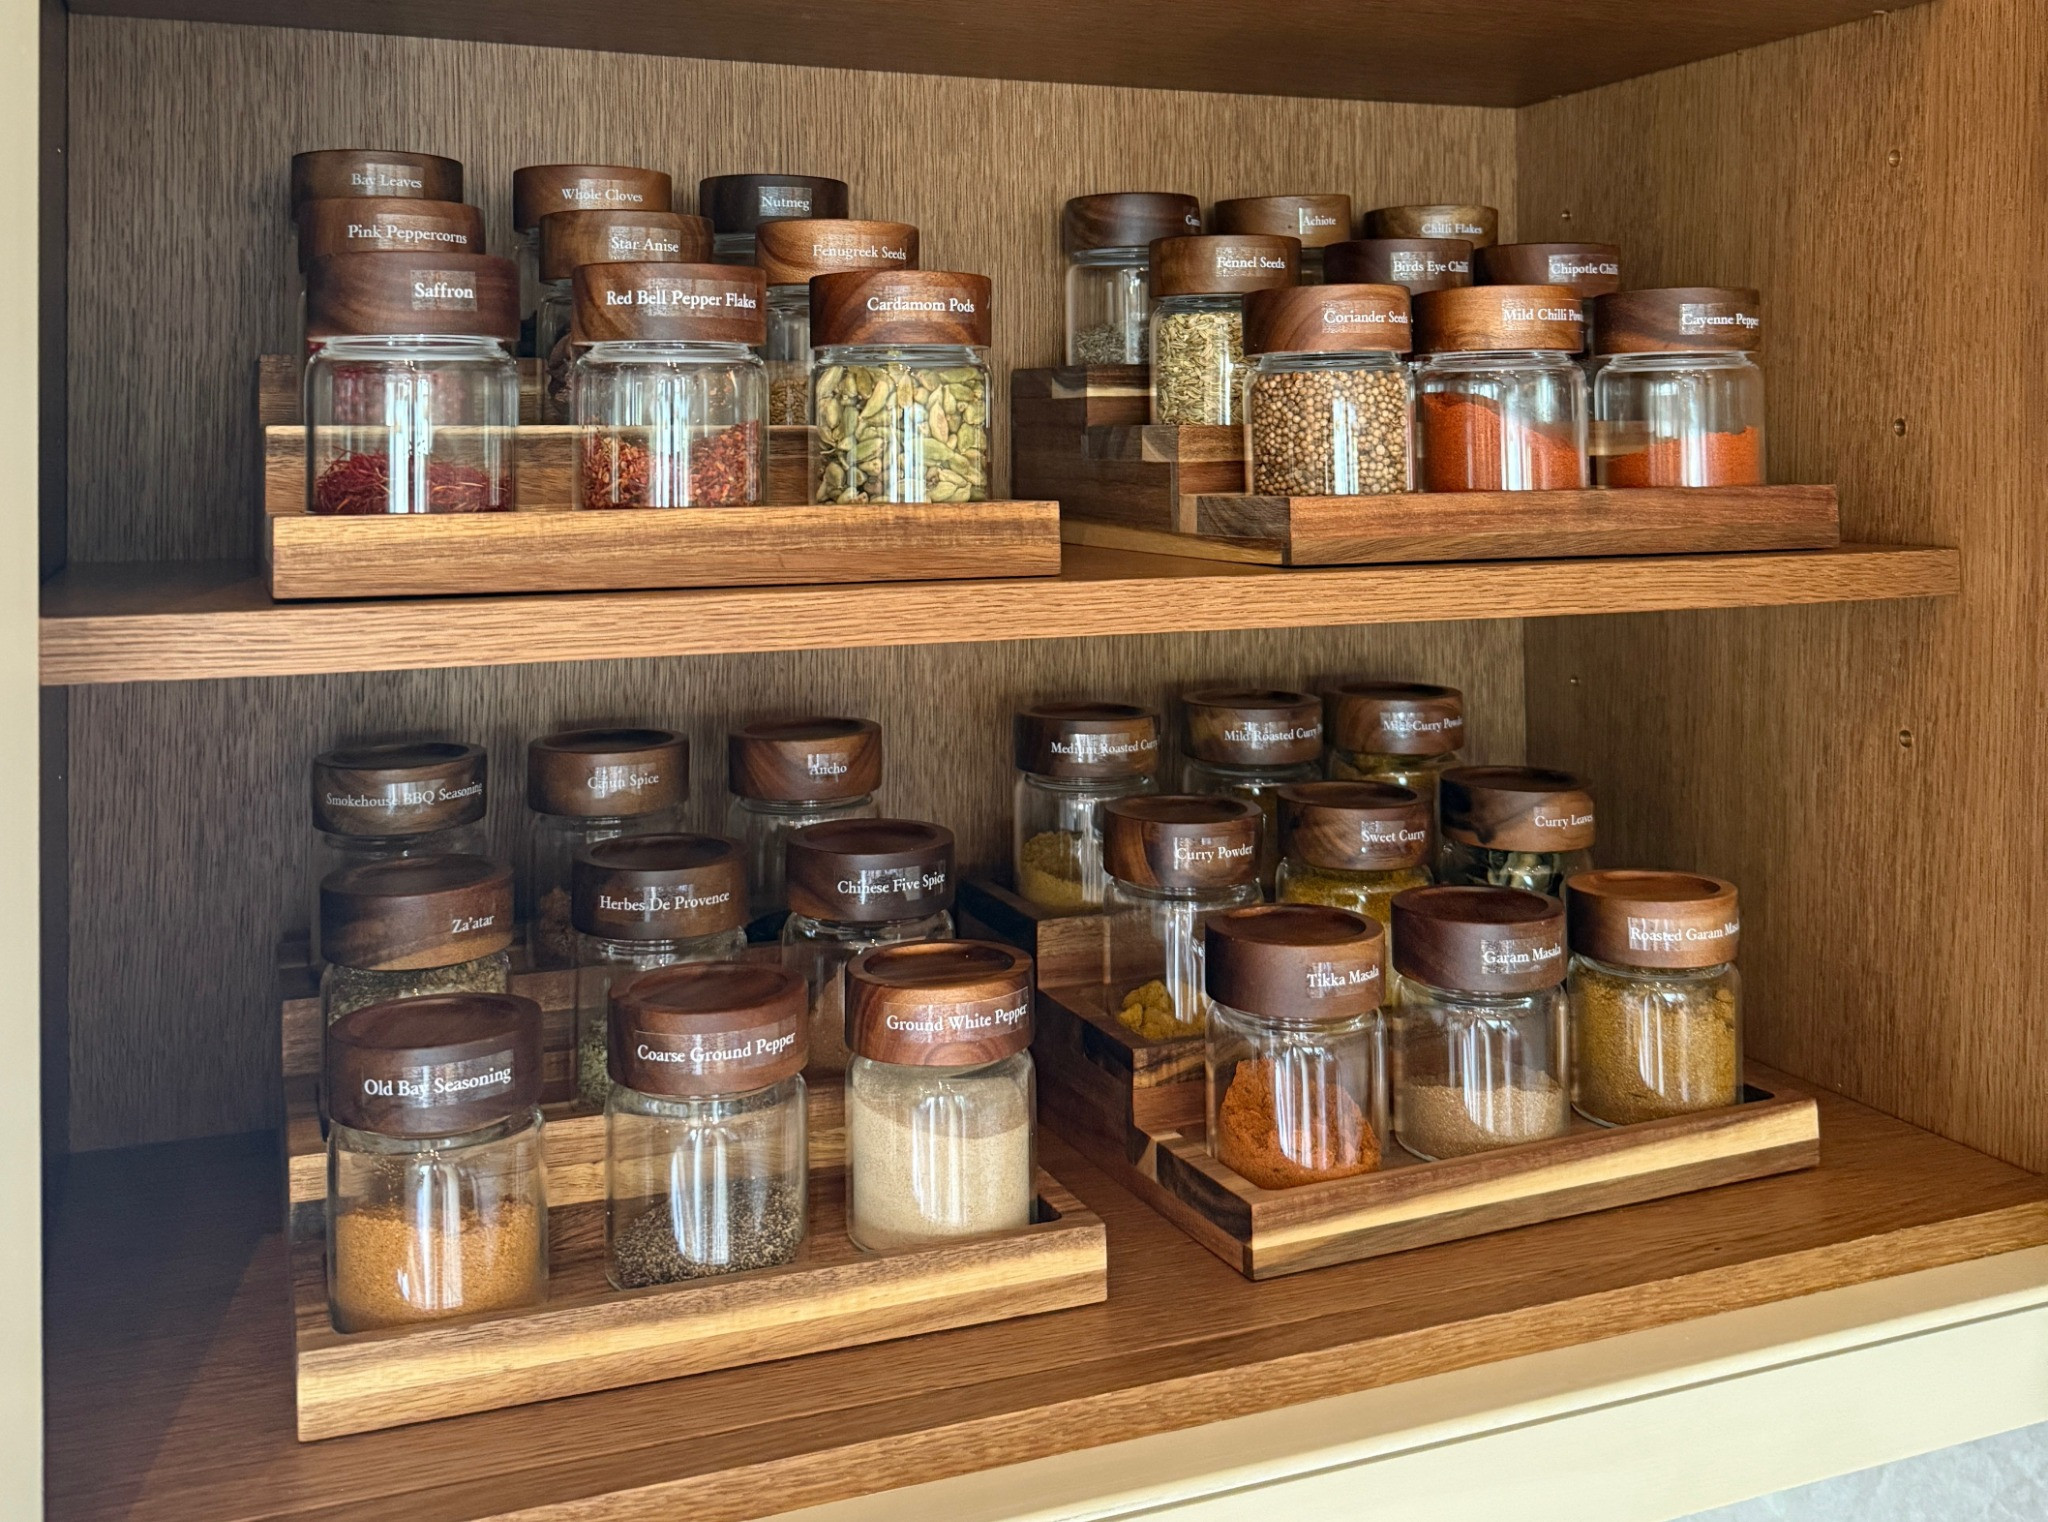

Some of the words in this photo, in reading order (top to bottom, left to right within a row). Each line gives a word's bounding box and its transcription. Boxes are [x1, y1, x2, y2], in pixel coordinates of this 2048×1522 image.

[351, 173, 378, 188] Bay
[380, 174, 422, 189] Leaves
[562, 188, 601, 202] Whole
[605, 188, 643, 203] Cloves
[761, 195, 810, 212] Nutmeg
[1302, 215, 1337, 227] Achiote
[1421, 223, 1453, 235] Chilli
[1455, 223, 1483, 235] Flakes
[347, 224, 382, 239] Pink
[386, 225, 467, 245] Peppercorns
[611, 237, 640, 251] Star
[643, 238, 679, 253] Anise
[812, 244, 878, 260] Fenugreek
[881, 245, 906, 261] Seeds
[1217, 256, 1257, 269] Fennel
[1260, 256, 1285, 270] Seeds
[1394, 260, 1424, 272] Birds
[1427, 260, 1446, 275] Eye
[1551, 262, 1599, 277] Chipotle
[414, 281, 474, 300] Saffron
[606, 290, 633, 305] Red
[637, 289, 667, 305] Bell
[671, 290, 723, 310] Pepper
[725, 291, 756, 309] Flakes
[866, 297, 945, 312] Cardamom
[949, 298, 975, 314] Pods
[1323, 308, 1387, 324] Coriander
[1503, 307, 1535, 321] Mild
[1537, 307, 1567, 321] Chilli
[1682, 313, 1734, 328] Cayenne
[1224, 729, 1250, 741] Mild
[1252, 728, 1294, 741] Roasted
[1412, 720, 1442, 733] Curry
[1100, 740, 1138, 754] Roasted
[808, 762, 848, 776] Ancho
[629, 772, 659, 789] Spice
[326, 792, 398, 807] Smokehouse
[403, 790, 435, 806] BBQ
[438, 781, 483, 800] Seasoning
[1534, 815, 1569, 830] Curry
[1361, 830, 1396, 843] Sweet
[1399, 829, 1426, 844] Curry
[1176, 846, 1213, 863] Curry
[1218, 843, 1254, 859] Powder
[837, 879, 890, 895] Chinese
[892, 877, 920, 892] Five
[922, 870, 945, 889] Spice
[600, 895, 645, 912] Herbes
[650, 896, 671, 912] De
[674, 890, 730, 911] Provence
[451, 913, 495, 934] Za'atar
[1631, 926, 1682, 942] Roasted
[1685, 927, 1723, 941] Garam
[1483, 950, 1530, 964] Garam
[1306, 972, 1346, 988] Tikka
[886, 1014, 944, 1033] Ground
[947, 1012, 991, 1032] White
[994, 1002, 1028, 1028] Pepper
[636, 1043, 686, 1063] Coarse
[690, 1042, 752, 1063] Ground
[755, 1030, 797, 1056] Pepper
[364, 1079, 393, 1097] Old
[397, 1080, 427, 1100] Bay
[433, 1066, 511, 1094] Seasoning
